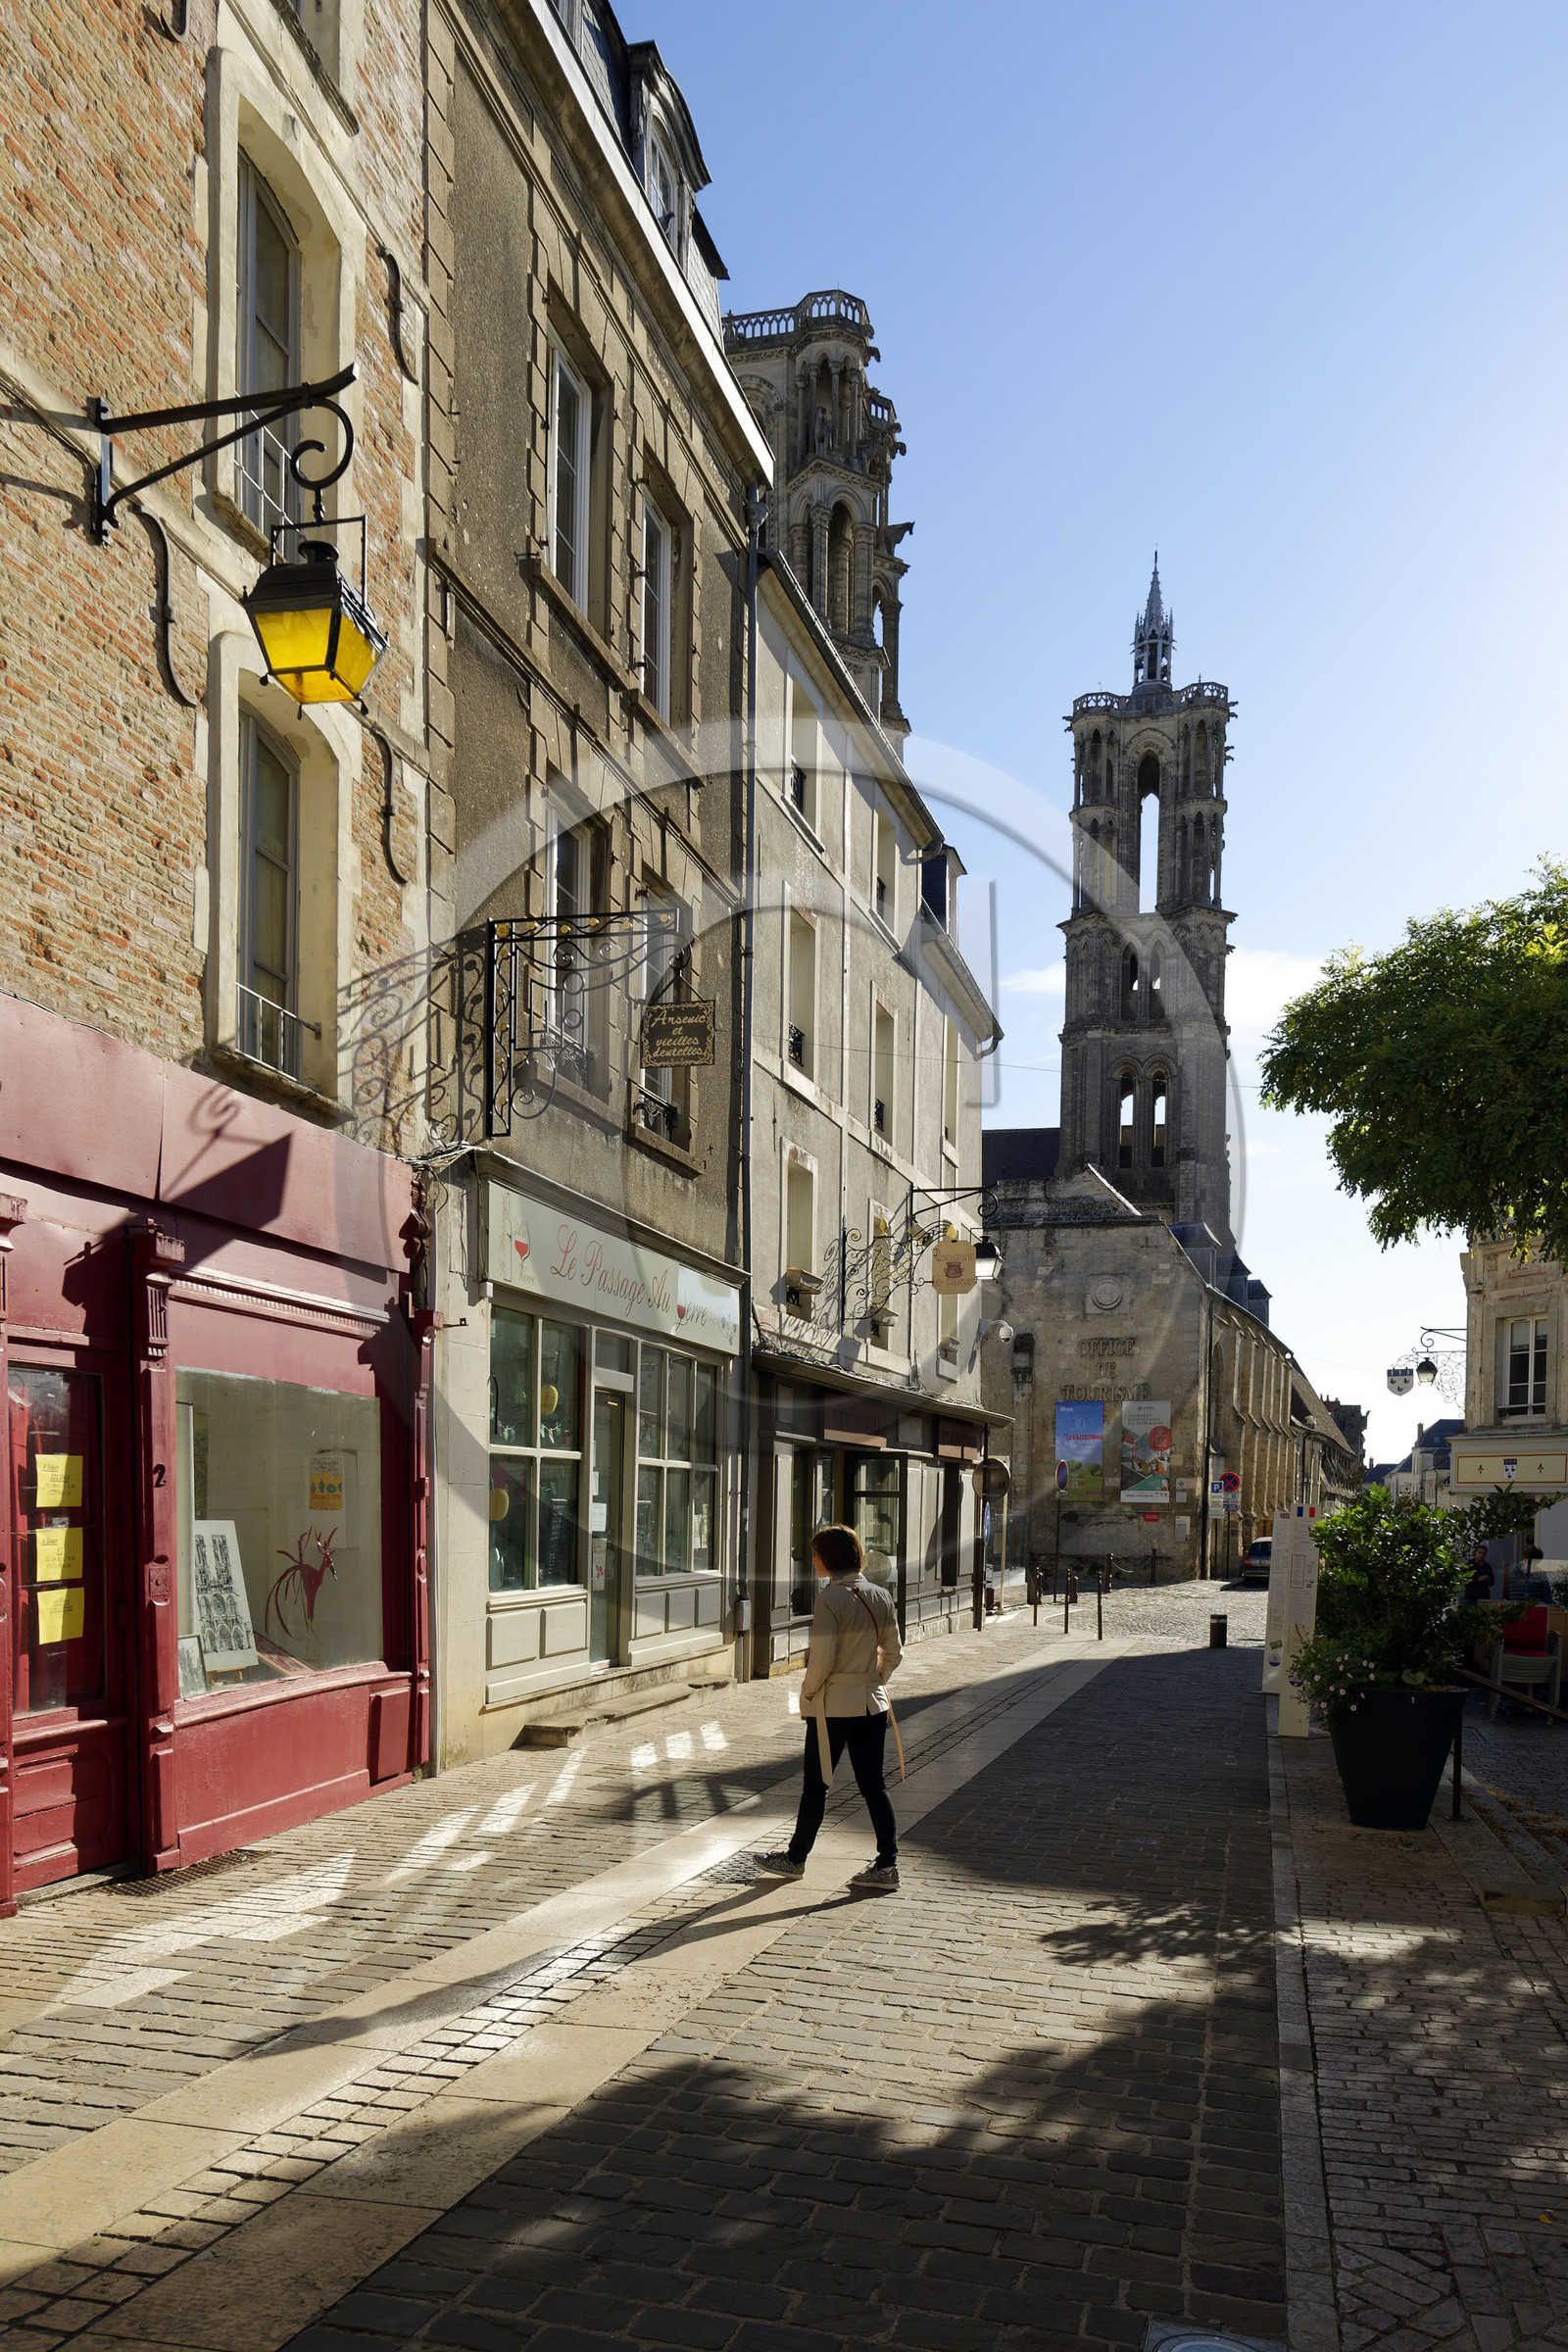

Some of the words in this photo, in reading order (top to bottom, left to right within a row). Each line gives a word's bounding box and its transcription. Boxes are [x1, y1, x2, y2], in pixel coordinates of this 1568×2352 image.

[651, 1009, 707, 1028] Arsenic
[671, 1026, 683, 1036] et
[656, 1036, 700, 1047] vieilles
[652, 1047, 704, 1058] dentelles
[550, 1224, 577, 1280] Le
[581, 1241, 646, 1317] Passage
[648, 1269, 671, 1312] Au
[1078, 1339, 1136, 1356] OFFICE
[1096, 1362, 1117, 1380] DE
[1062, 1384, 1150, 1402] TOURISME
[153, 1464, 167, 1488] 2
